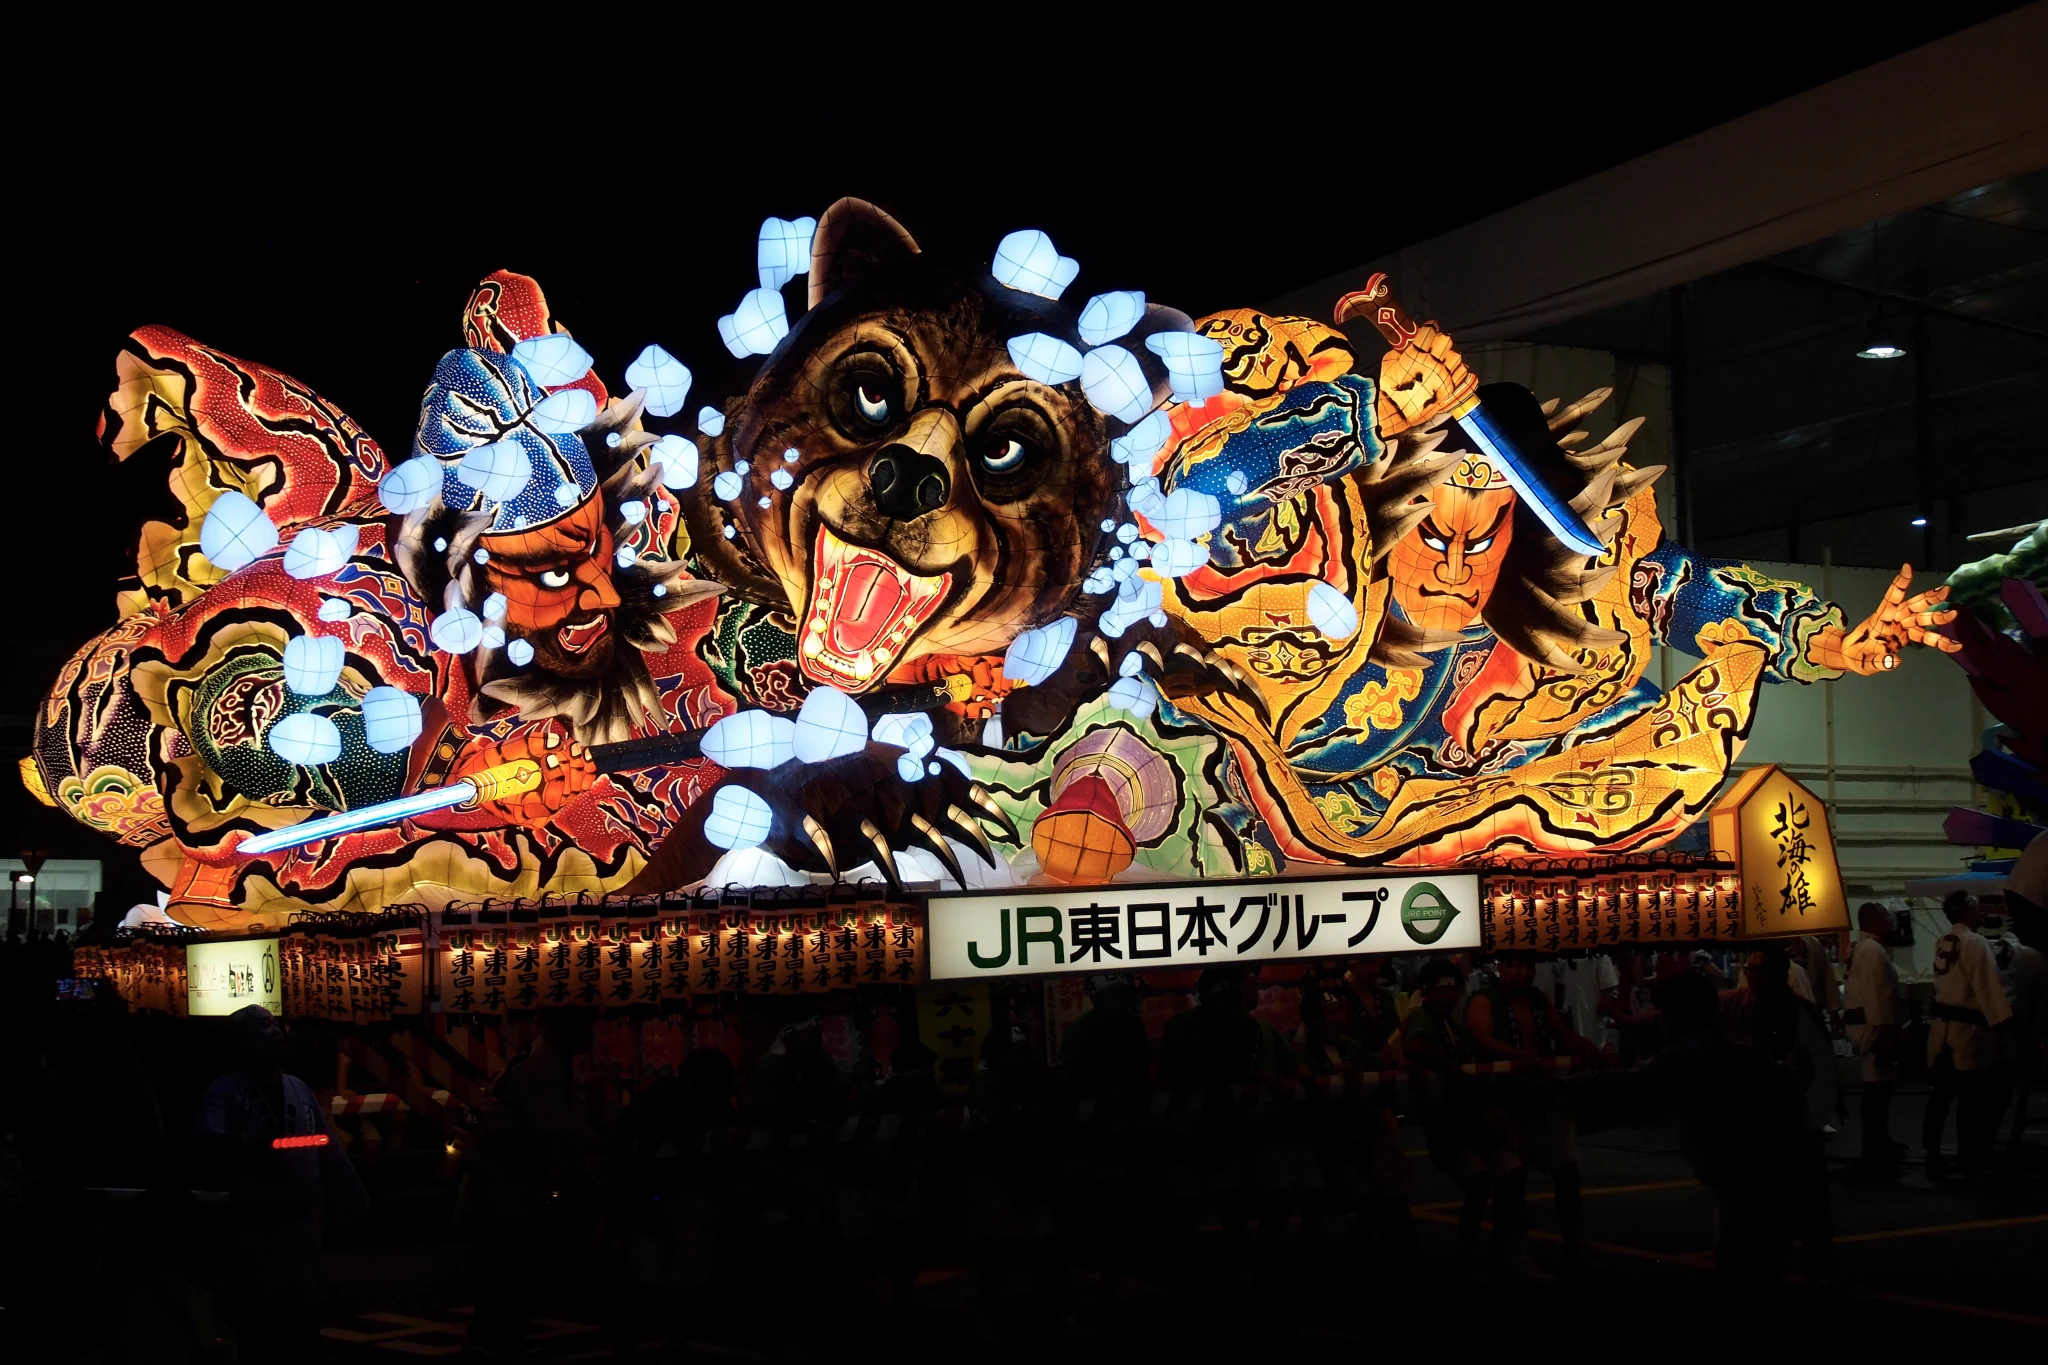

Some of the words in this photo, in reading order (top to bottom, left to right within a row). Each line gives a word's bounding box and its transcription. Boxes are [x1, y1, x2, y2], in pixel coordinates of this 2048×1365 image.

[1770, 791, 1817, 916] 北海の雄
[967, 886, 1390, 970] JR東日本グループ
[1423, 909, 1447, 917] POINT
[450, 951, 475, 1010] 東日本
[482, 950, 508, 1010] 東日本
[513, 947, 539, 1006] 東日本
[544, 942, 571, 1000] 東日本
[575, 942, 600, 1000] 東日本
[606, 942, 633, 1001] 東日本
[640, 942, 662, 1000] 東日本
[664, 936, 689, 992] 東日本
[697, 933, 720, 990] 東日本
[725, 930, 749, 989] 東日本
[754, 935, 777, 992] 東日本
[782, 934, 804, 990] 東日本
[809, 931, 831, 986] 東日本
[834, 927, 857, 983] 東日本
[861, 924, 886, 980] 東日本
[890, 926, 915, 980] 東日本
[933, 992, 977, 1085] 六十年
